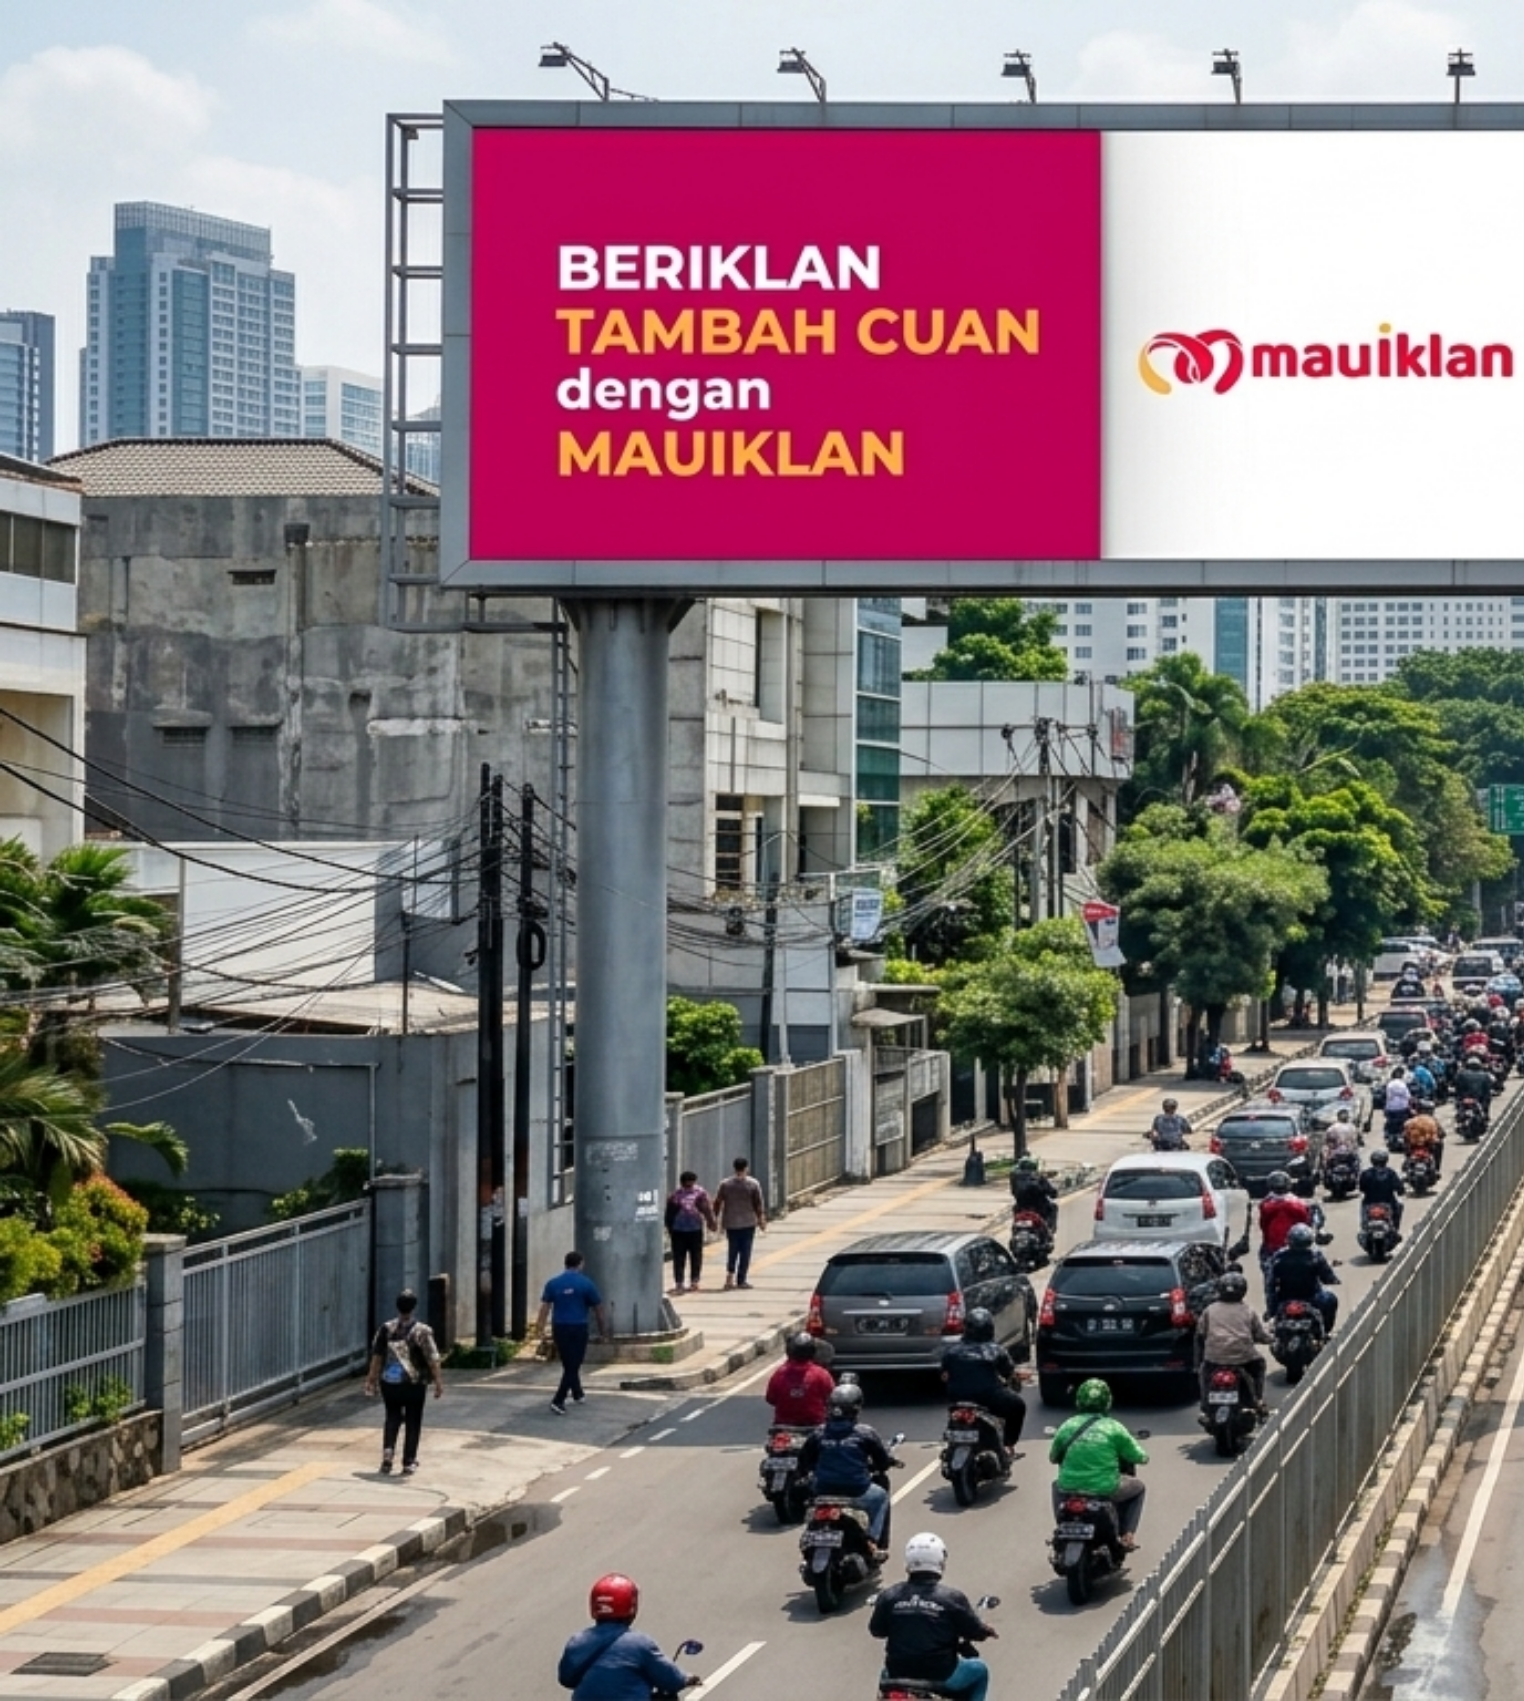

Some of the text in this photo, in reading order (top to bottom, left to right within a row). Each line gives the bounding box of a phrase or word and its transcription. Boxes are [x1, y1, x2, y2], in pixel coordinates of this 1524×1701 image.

[560, 244, 880, 290] BERIKLAN
[556, 307, 1039, 355] TAMBAH CUAN
[1252, 322, 1514, 378] mauiklan
[556, 366, 771, 421] dengan
[559, 430, 904, 477] MAUIKLAN
